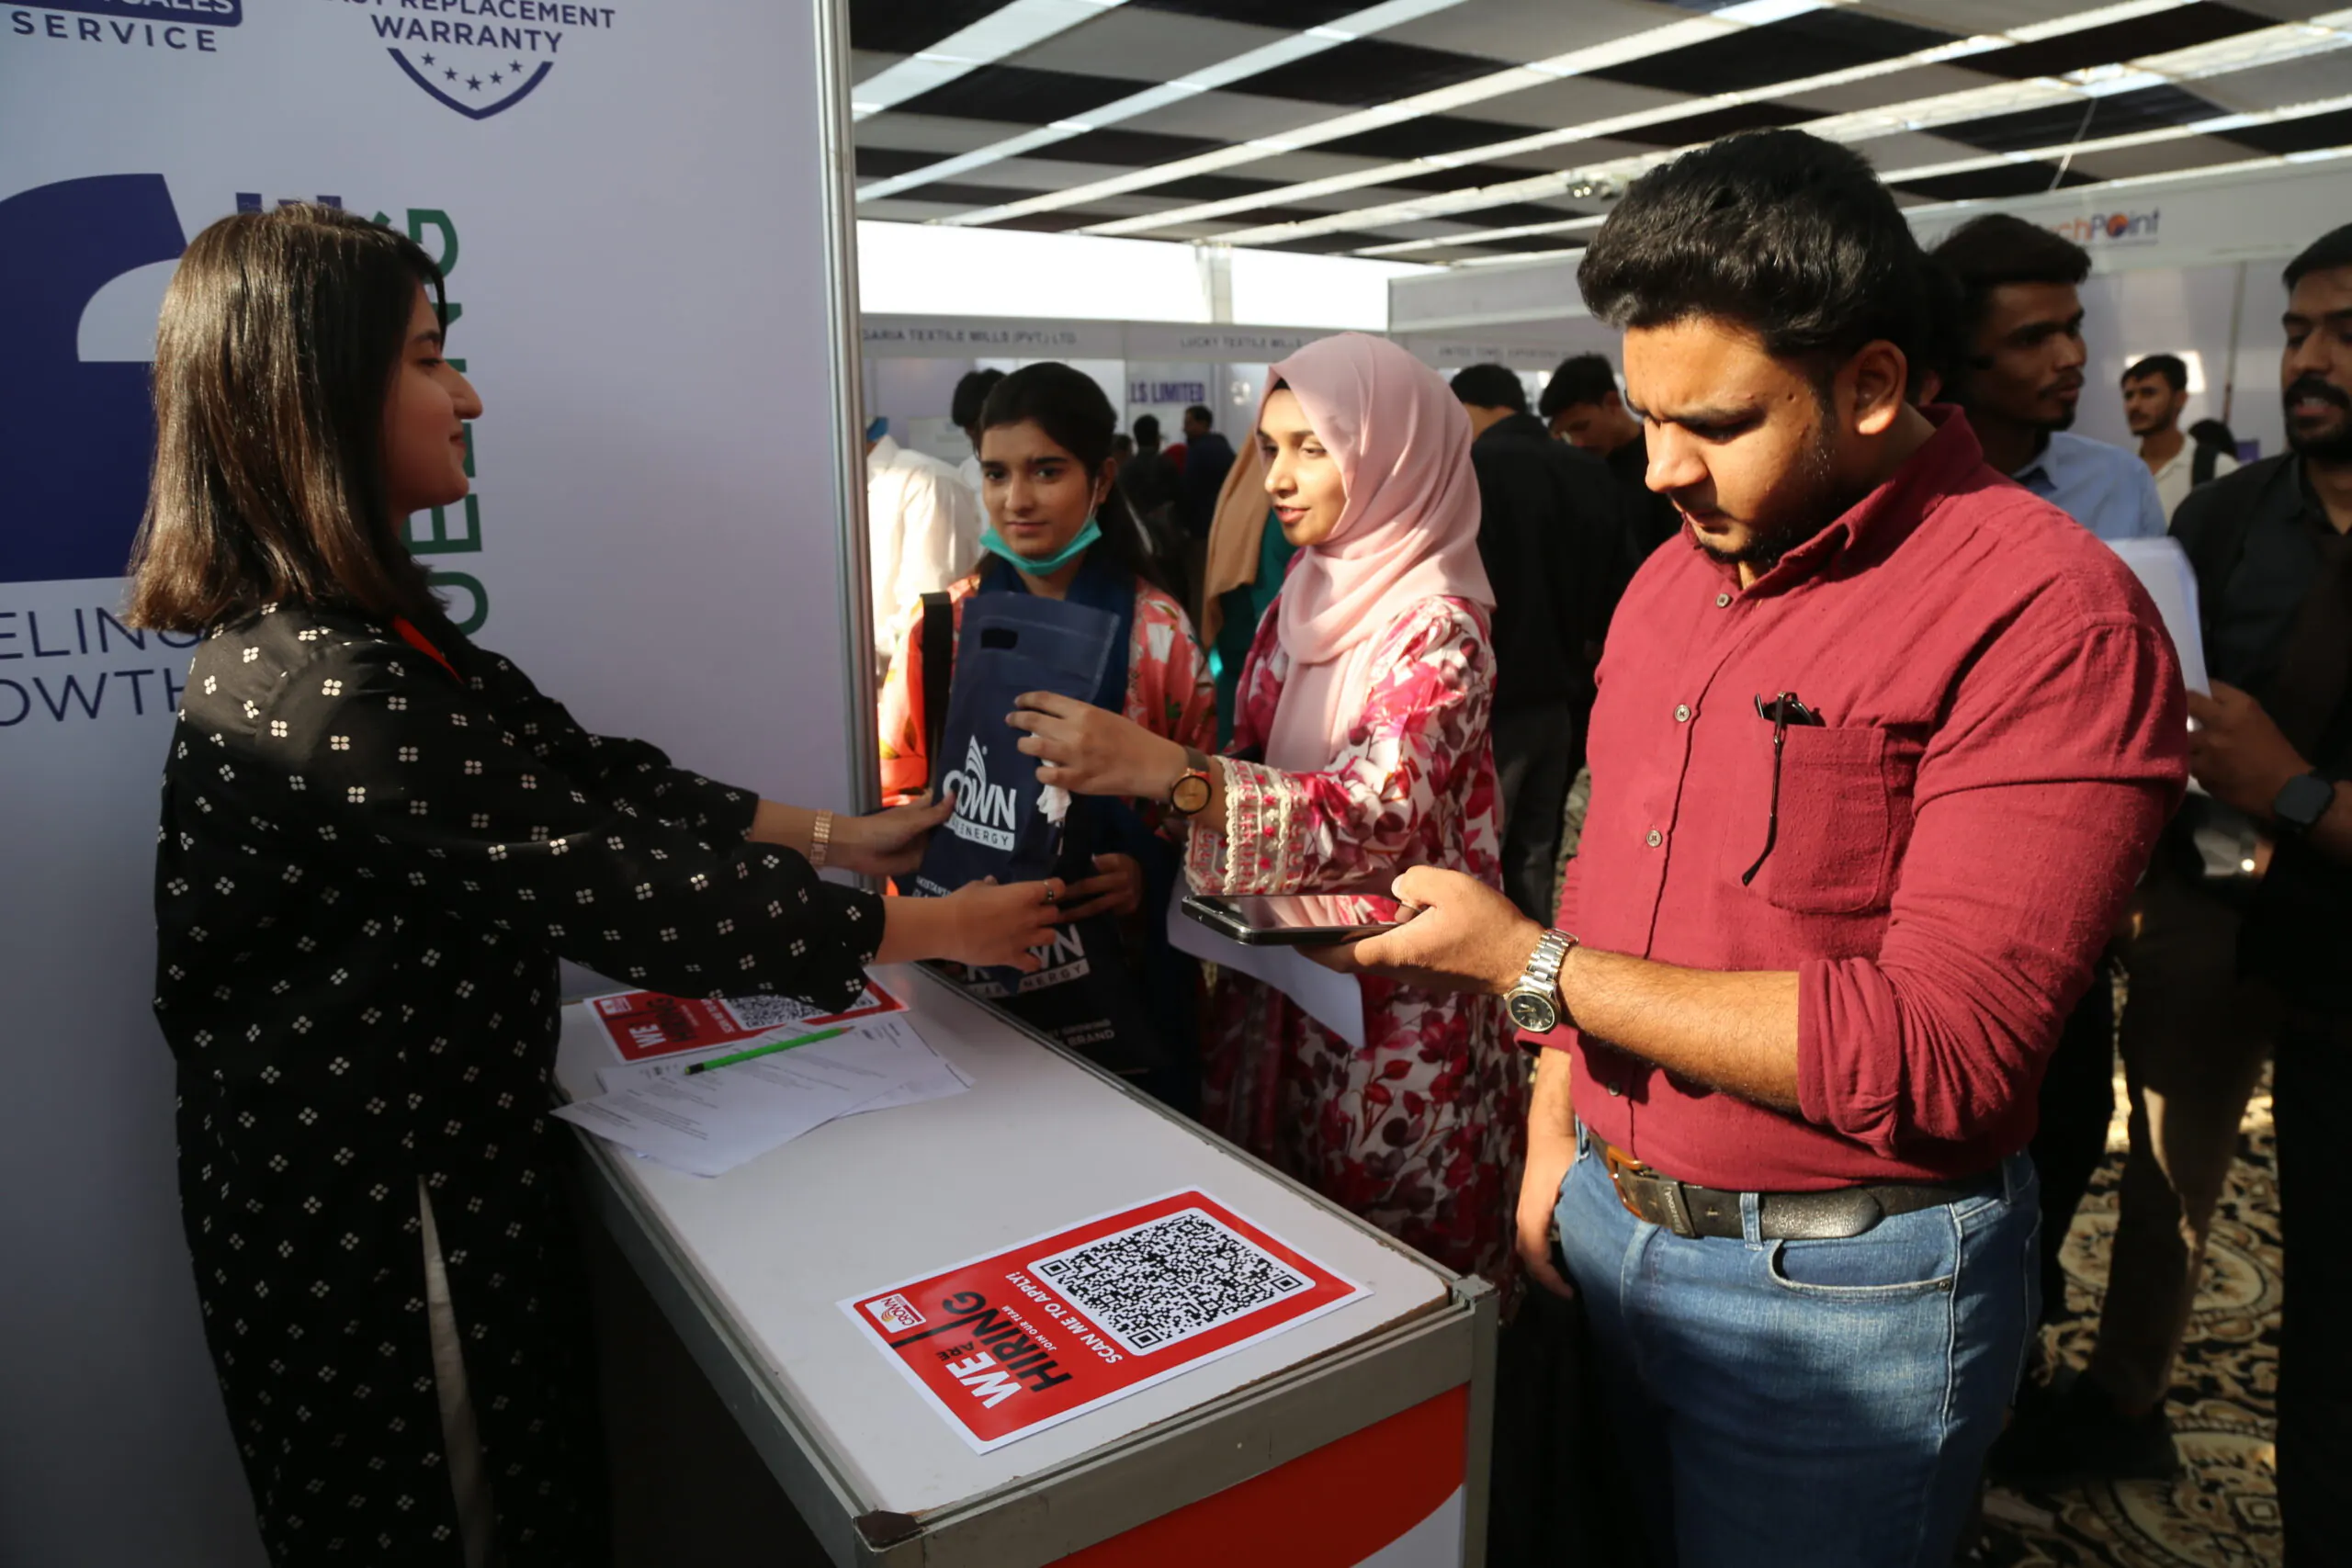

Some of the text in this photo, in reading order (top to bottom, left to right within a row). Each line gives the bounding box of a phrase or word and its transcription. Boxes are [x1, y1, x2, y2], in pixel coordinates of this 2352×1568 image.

[11, 10, 217, 52] SERVICE
[370, 14, 562, 52] WARRANTY
[910, 329, 964, 343] TEXTILE
[969, 330, 1009, 344] MILLS
[1151, 380, 1205, 403] LIMITED
[1022, 963, 1083, 988] NERGY
[628, 1023, 667, 1049] WE
[1067, 1028, 1115, 1047] BRAND
[1001, 1305, 1057, 1352] JOIN OUR TEAM
[1005, 1271, 1124, 1364] SCAN ME TO APPLY!
[942, 1291, 1073, 1392] HIRING
[936, 1340, 1022, 1409] WE ARE
